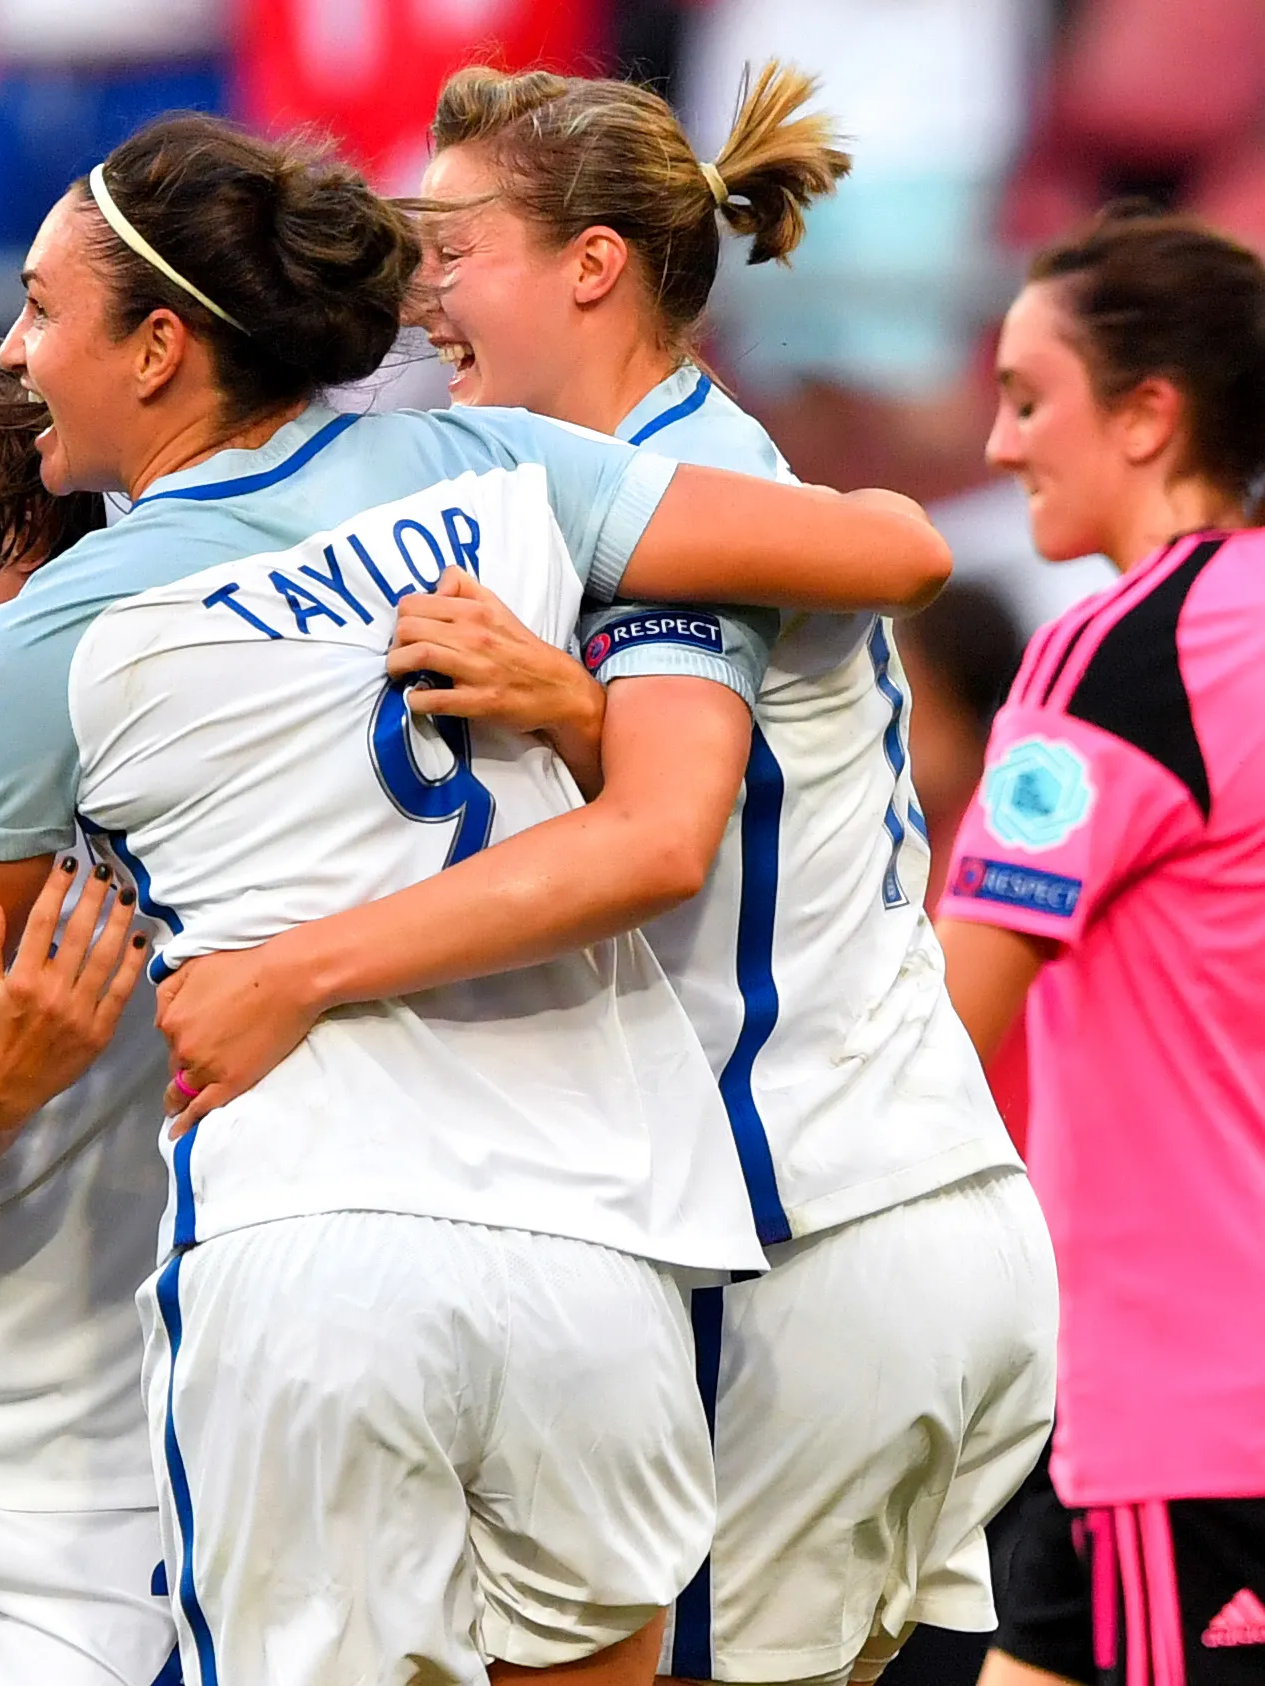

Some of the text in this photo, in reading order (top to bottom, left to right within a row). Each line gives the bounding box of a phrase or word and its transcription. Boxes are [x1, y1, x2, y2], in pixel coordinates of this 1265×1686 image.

[202, 507, 481, 641] TAYLOR
[613, 617, 719, 642] RESPECT
[367, 668, 496, 872] 9
